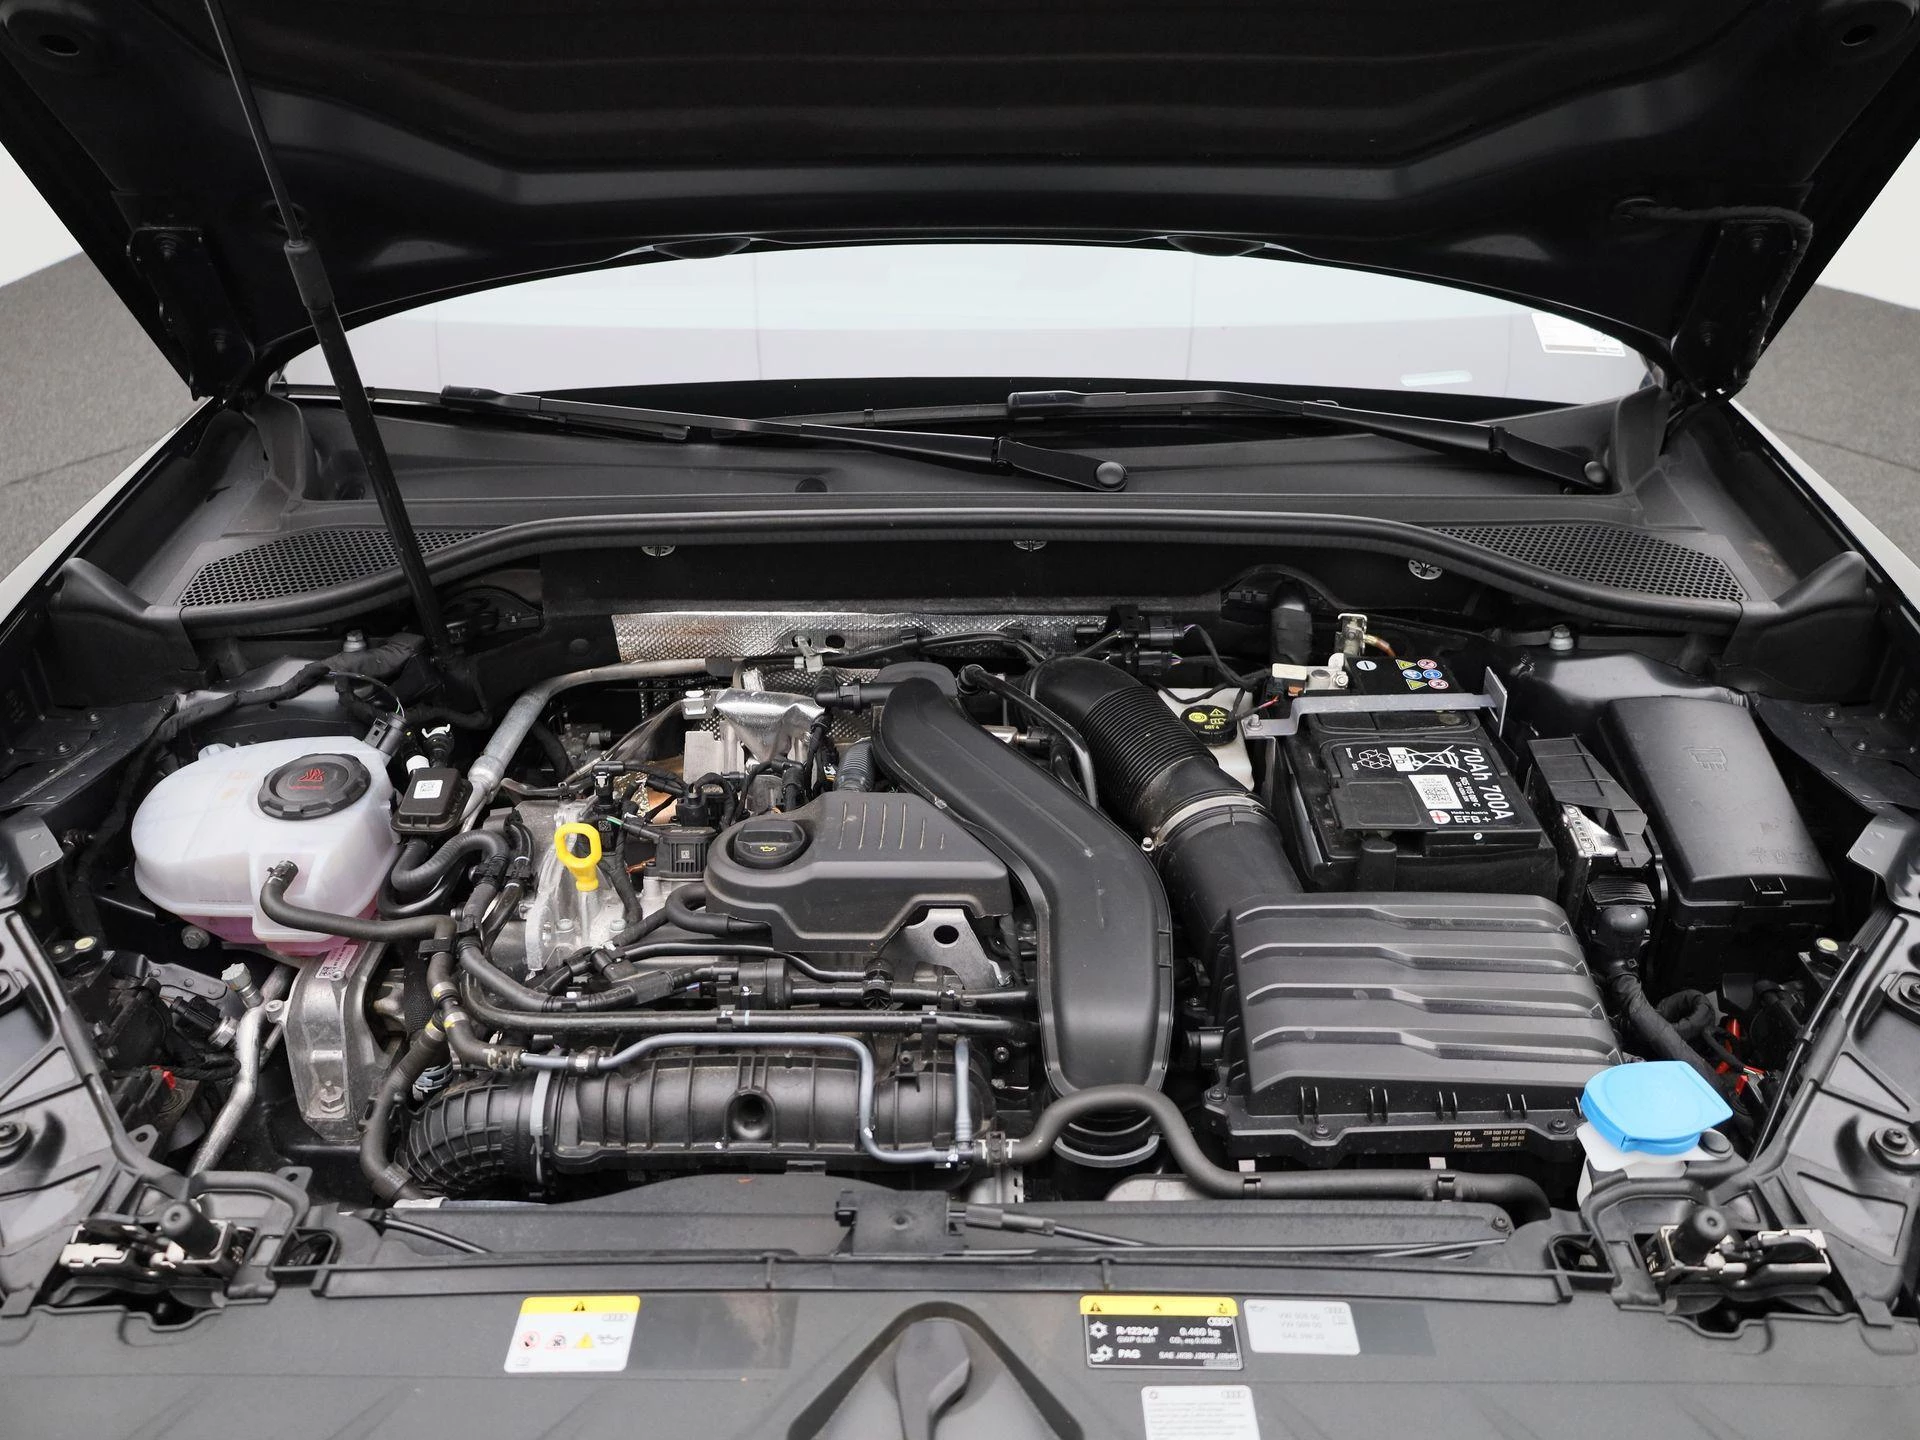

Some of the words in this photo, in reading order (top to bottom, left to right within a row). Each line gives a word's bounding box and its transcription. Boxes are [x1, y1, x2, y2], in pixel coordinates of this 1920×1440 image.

[1460, 748, 1492, 780] 70Ah
[1479, 785, 1514, 820] 700A
[1454, 815, 1481, 823] EFB
[1207, 1327, 1221, 1338] kg
[1117, 1348, 1142, 1359] PAG
